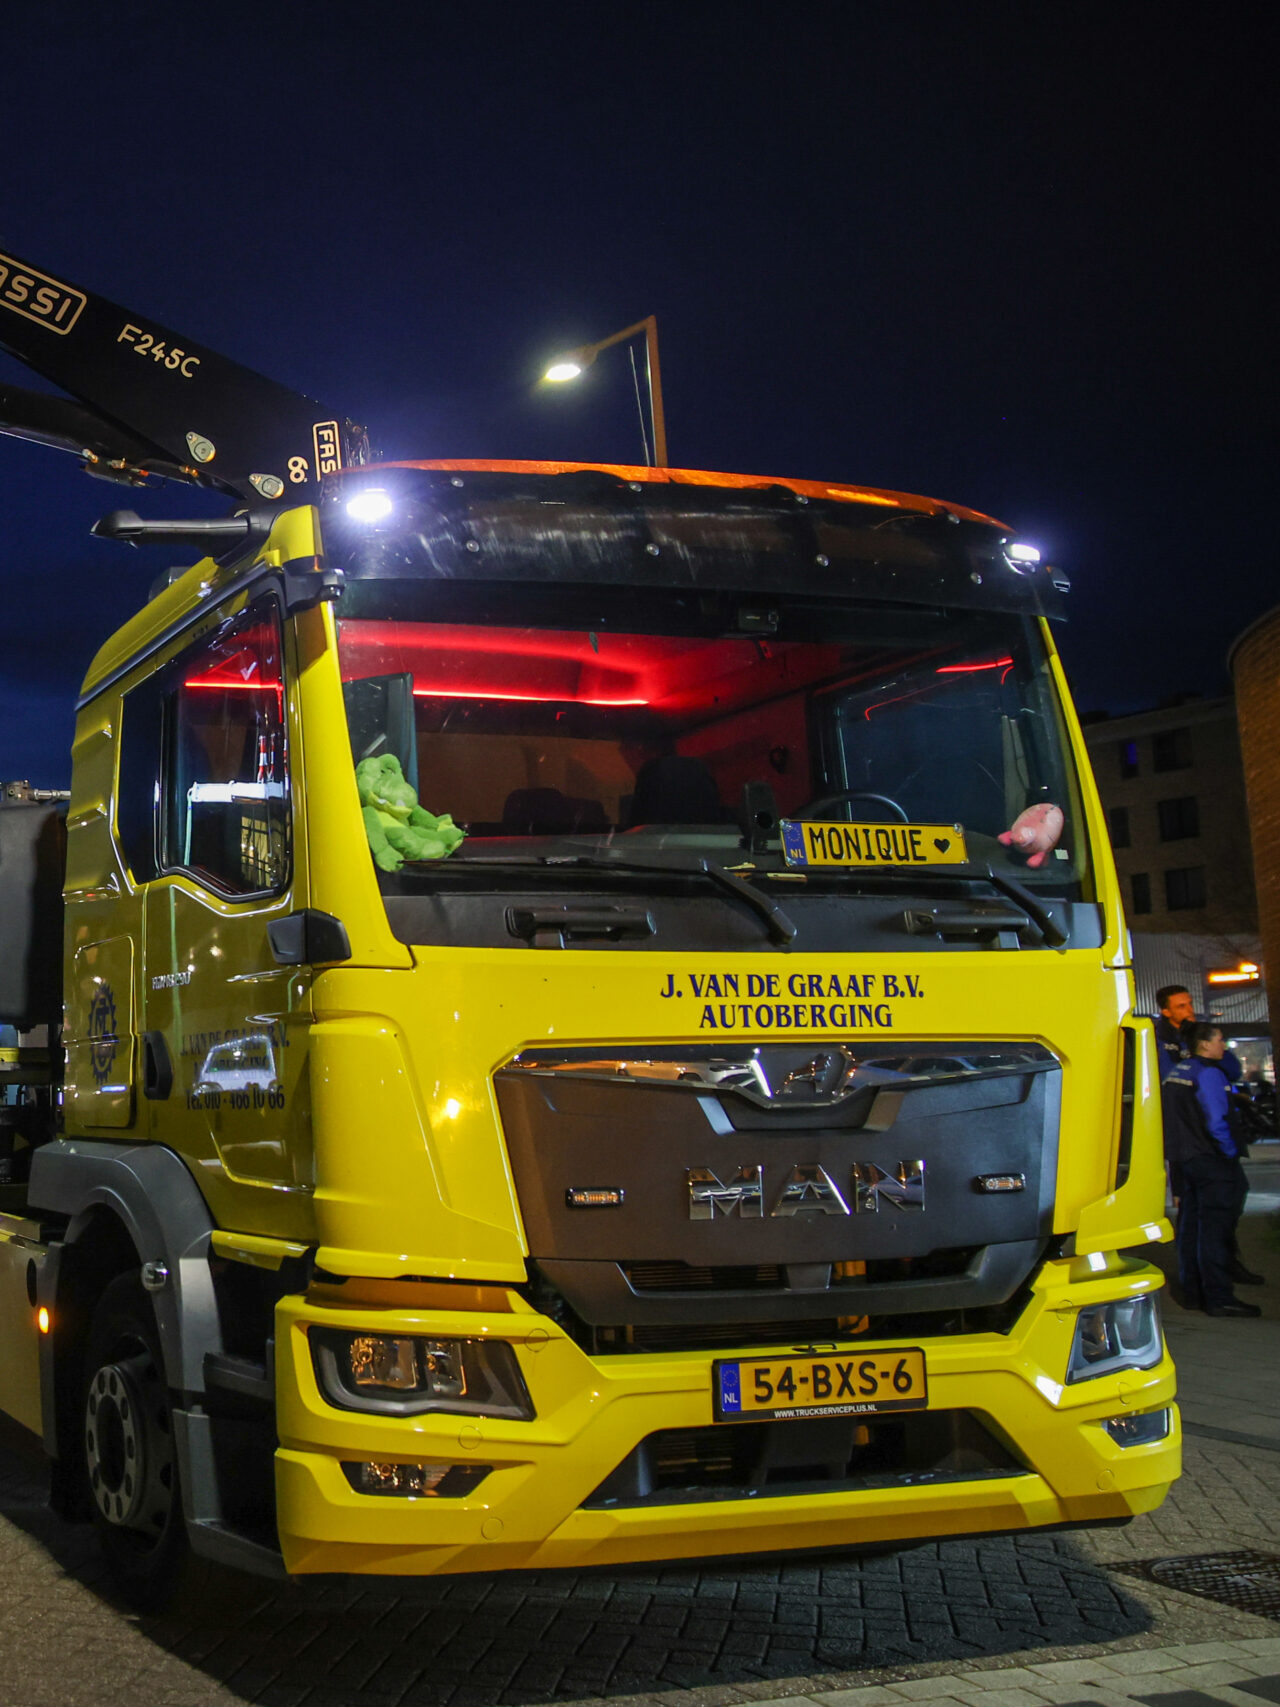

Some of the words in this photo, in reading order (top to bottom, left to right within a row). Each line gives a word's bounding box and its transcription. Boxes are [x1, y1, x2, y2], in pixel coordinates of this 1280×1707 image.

[117, 323, 201, 378] F245C
[809, 826, 928, 862] MONIQUE
[660, 973, 683, 999] J.
[688, 973, 739, 998] VAN
[746, 973, 781, 998] DE
[787, 973, 876, 998] GRAAF
[883, 974, 925, 999] B.V.
[699, 1004, 893, 1029] AUTOBERGING
[687, 1159, 926, 1220] MAN
[724, 1392, 738, 1404] NL
[754, 1358, 913, 1404] 54-BXS-6
[774, 1403, 878, 1419] WWW.TRUCKSERVICEPLUS.NL
